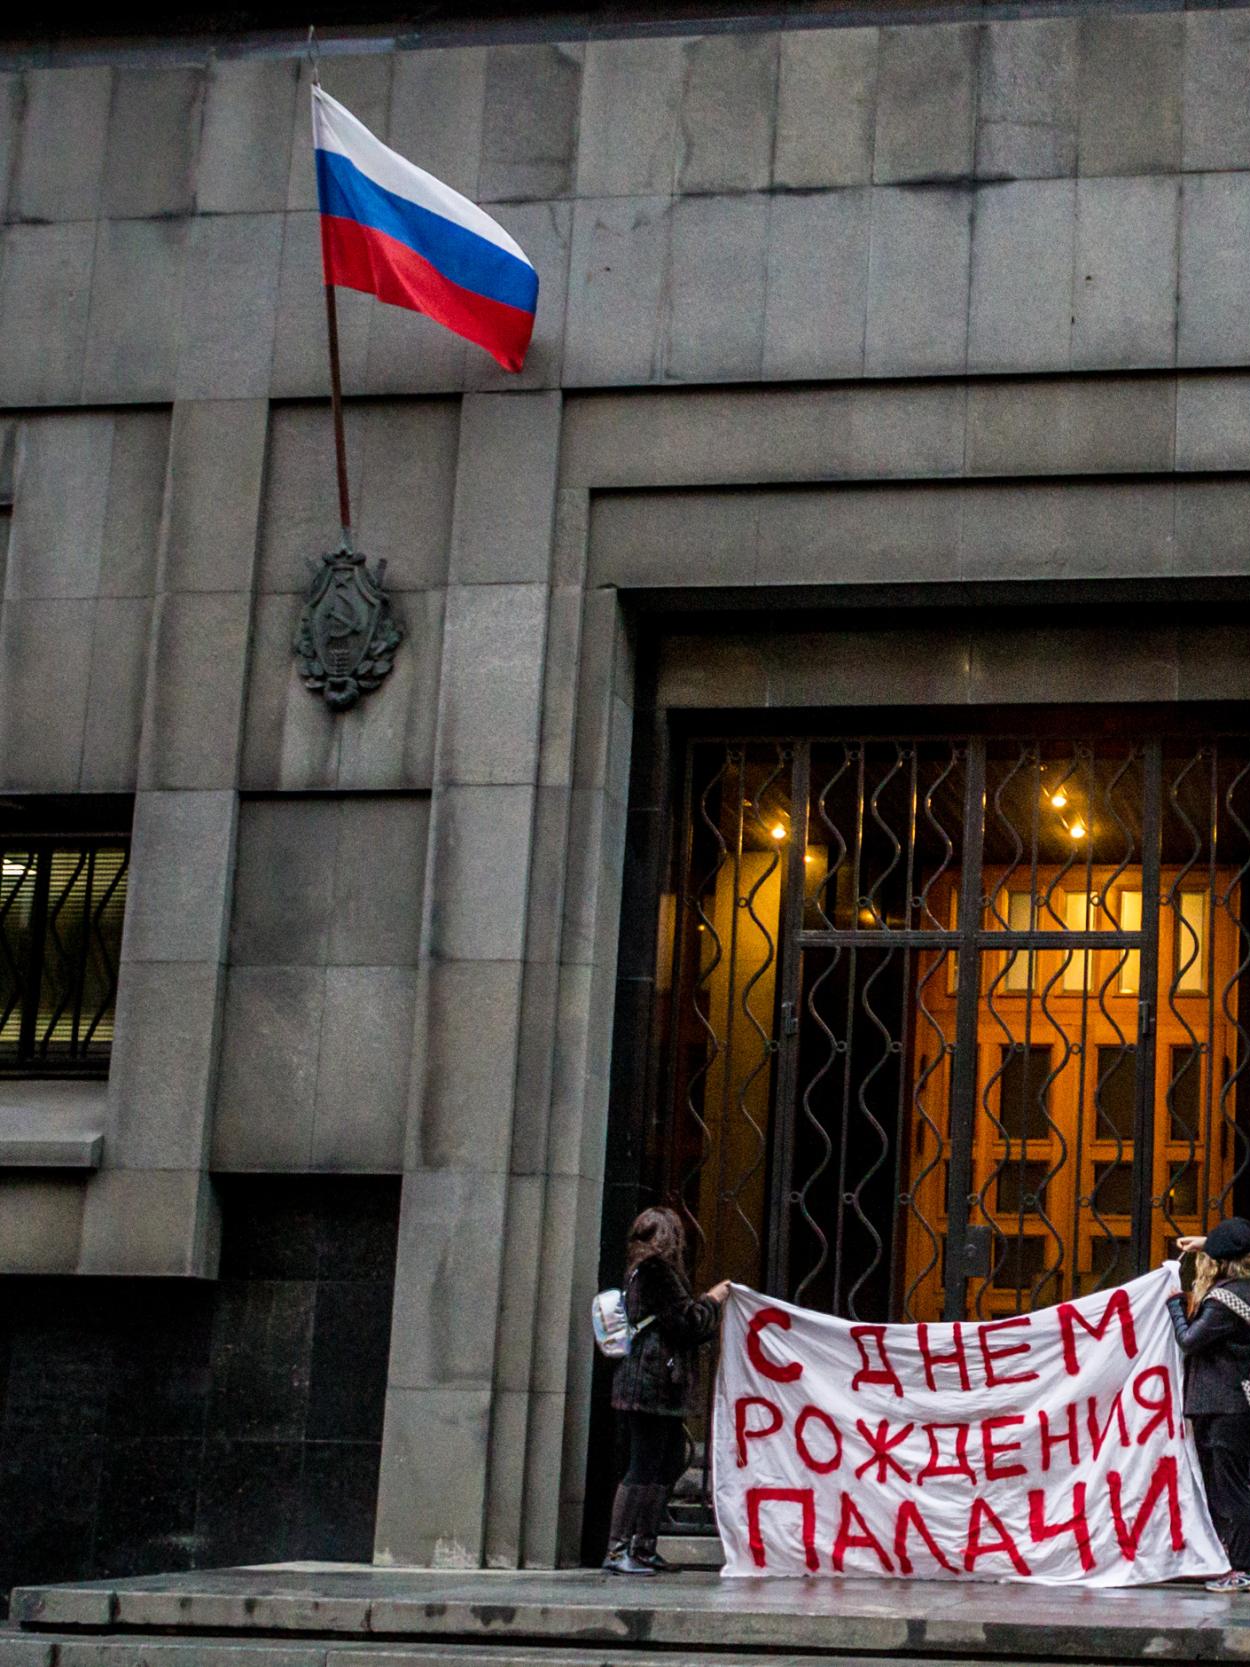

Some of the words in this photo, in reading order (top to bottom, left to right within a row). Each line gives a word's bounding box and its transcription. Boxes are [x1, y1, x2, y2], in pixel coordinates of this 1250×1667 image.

[747, 1307, 804, 1384] С
[850, 1288, 1138, 1399] ДНЕМ
[734, 1364, 1176, 1487] РОЖДЕНИЯ
[745, 1455, 1185, 1578] ПАЛАЧИ
